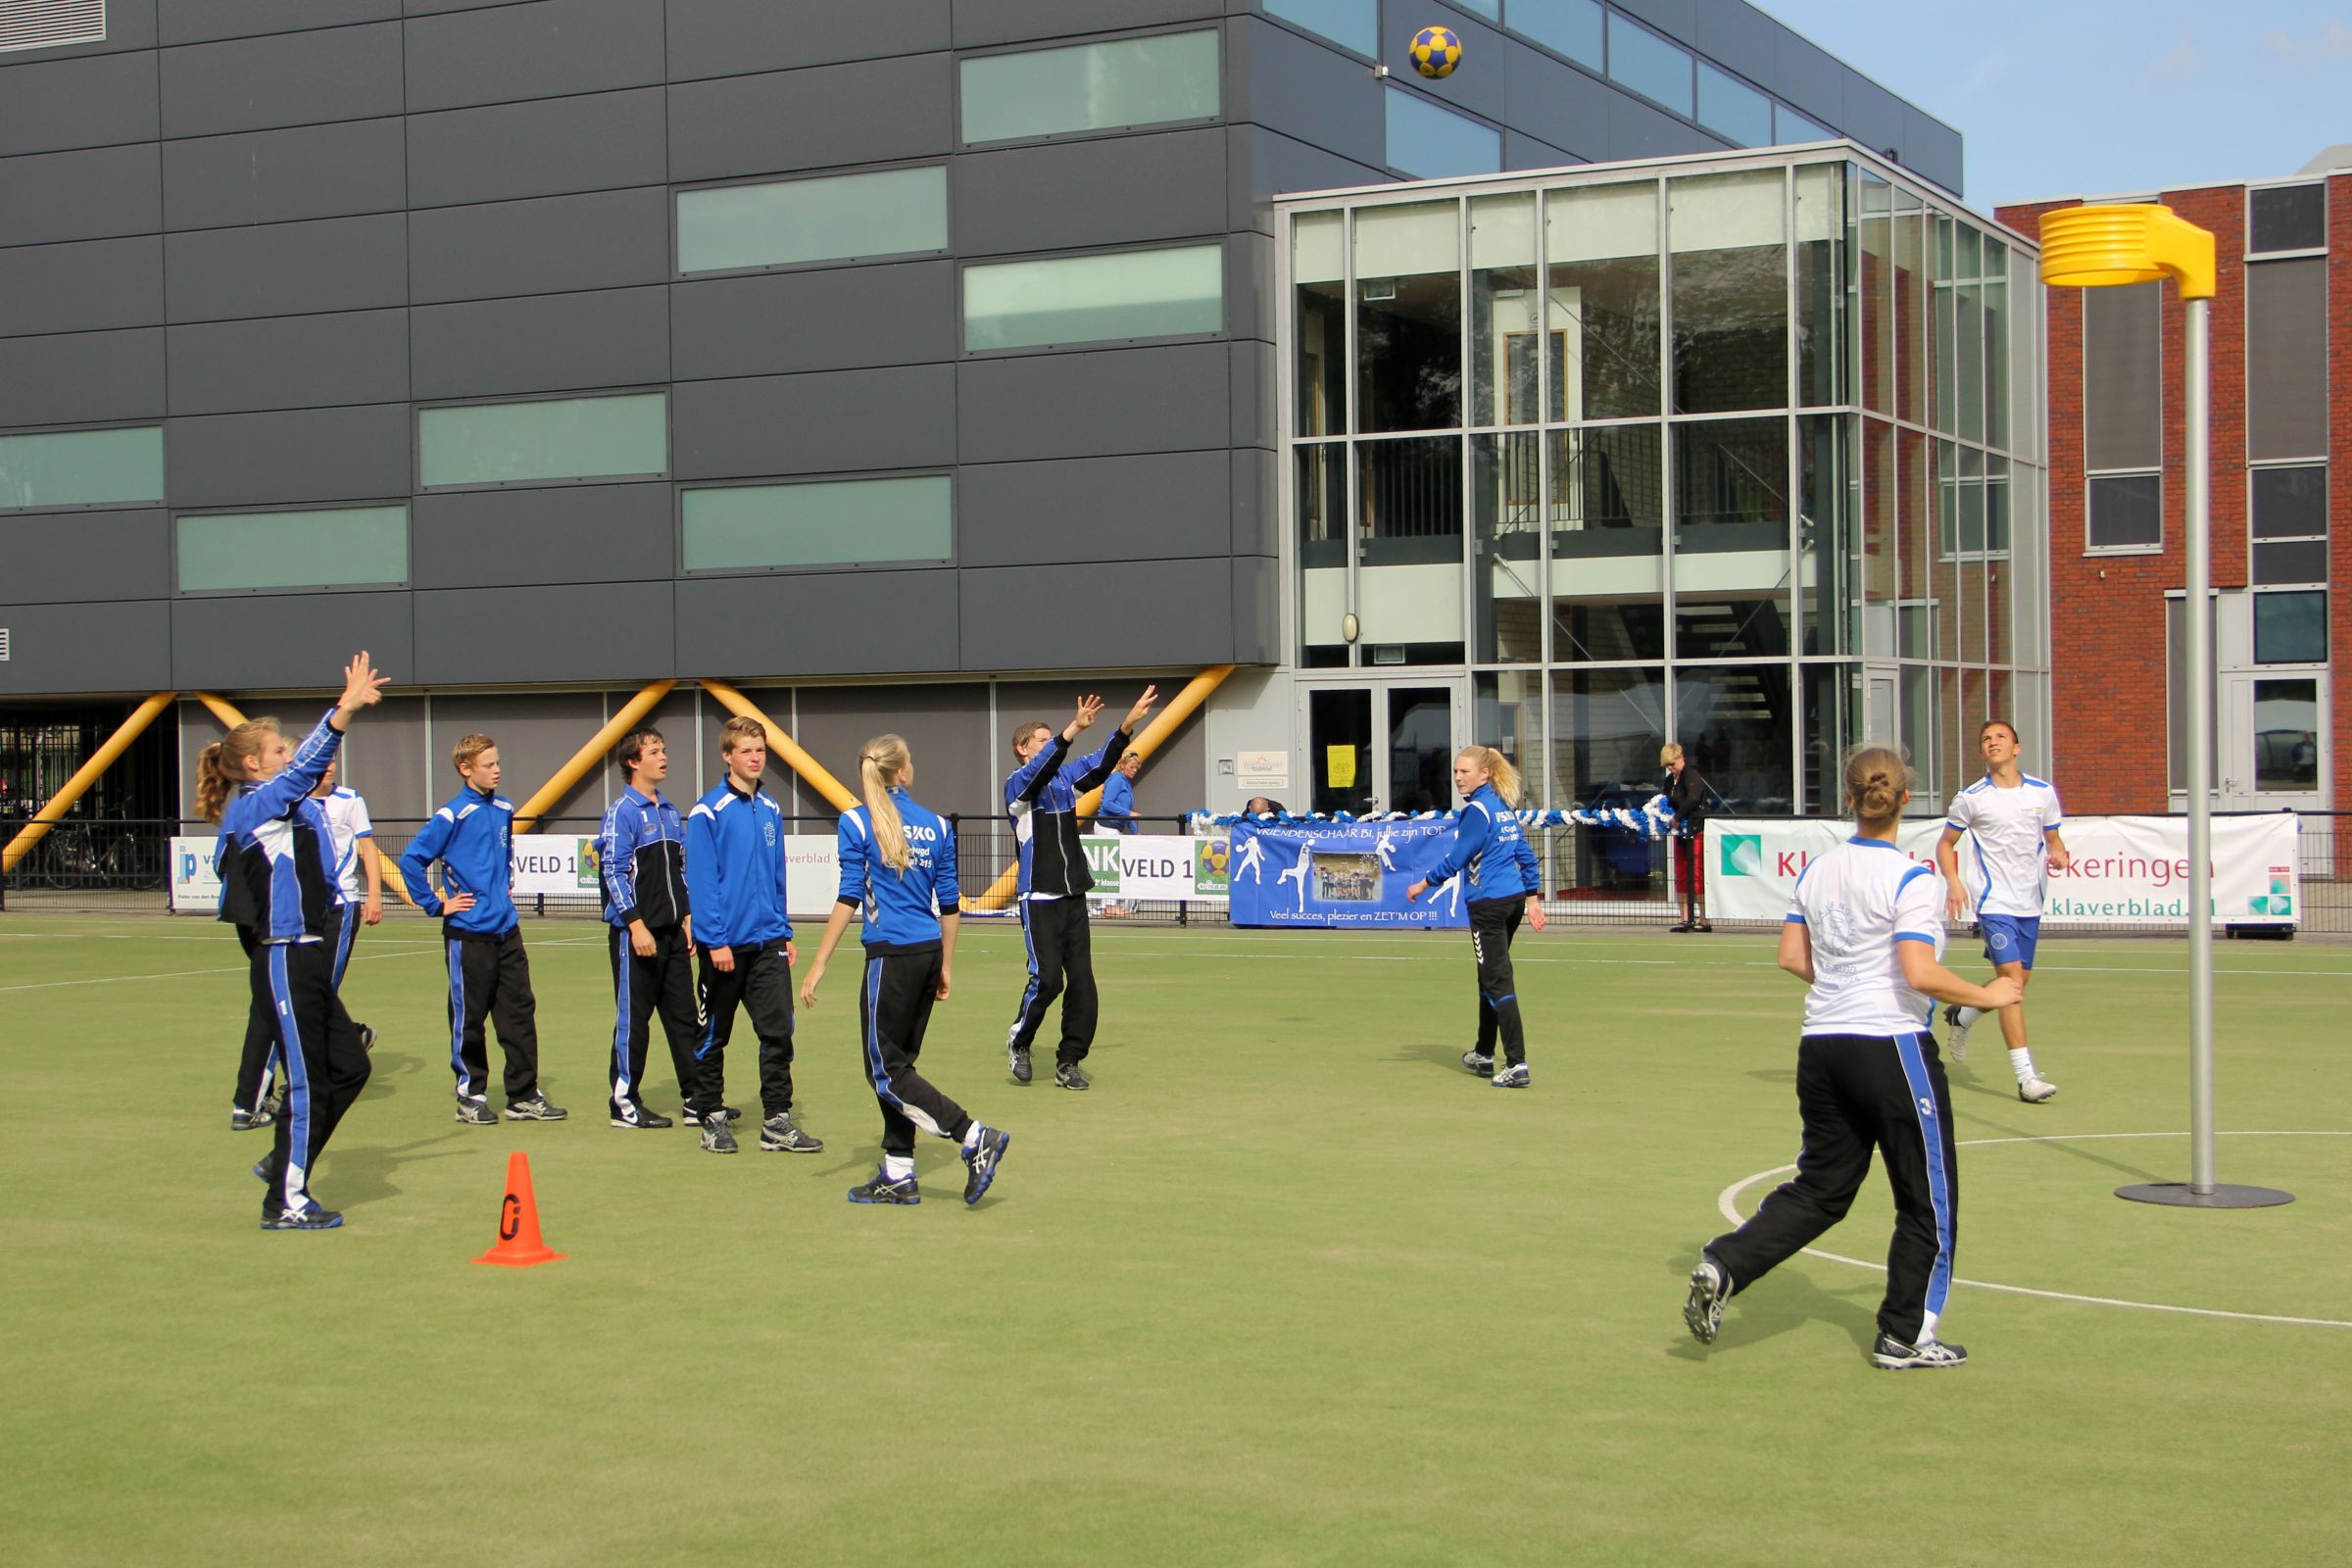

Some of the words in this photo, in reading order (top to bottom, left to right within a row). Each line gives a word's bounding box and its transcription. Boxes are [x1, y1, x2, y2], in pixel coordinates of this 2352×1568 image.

[641, 810, 648, 822] 1
[903, 825, 936, 842] SKO
[1256, 827, 1357, 839] VRIENDENSCHAAR
[1373, 824, 1399, 844] jullie
[1400, 825, 1418, 844] zijn
[1420, 825, 1446, 837] TOP
[515, 856, 561, 873] VELD
[567, 856, 576, 873] 1
[1082, 845, 1120, 872] NK
[1121, 858, 1175, 878] VELD
[1183, 859, 1194, 879] 1
[1101, 878, 1120, 887] klasse
[1269, 907, 1289, 920] Veel
[1290, 910, 1326, 922] succes,
[1327, 907, 1358, 925] plezier
[1359, 912, 1372, 921] en
[1373, 911, 1408, 921] ZET'M
[1409, 911, 1426, 921] OP
[1428, 910, 1438, 921] !!!
